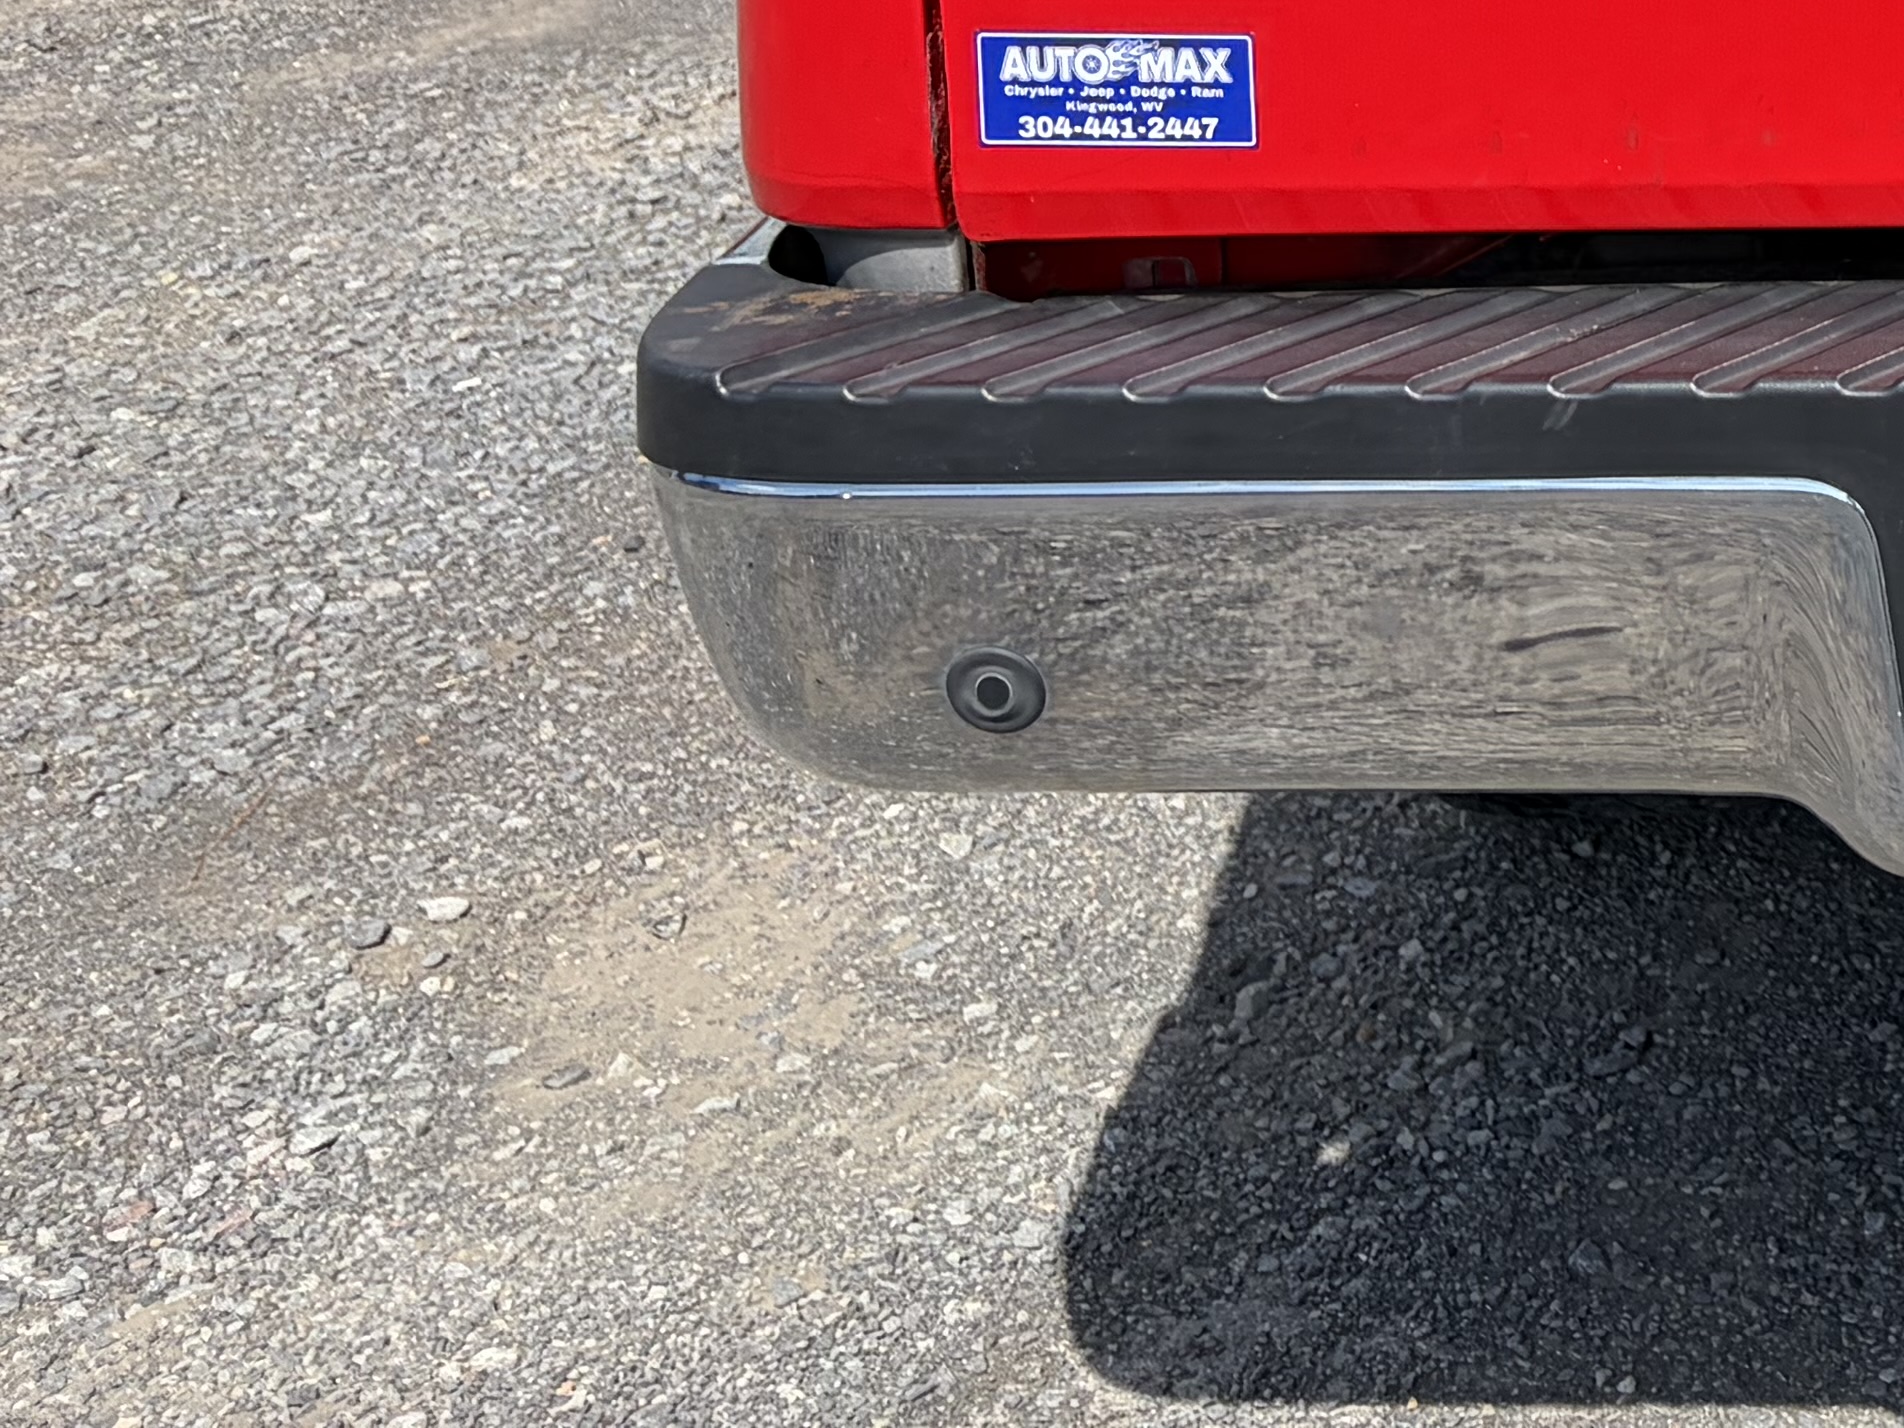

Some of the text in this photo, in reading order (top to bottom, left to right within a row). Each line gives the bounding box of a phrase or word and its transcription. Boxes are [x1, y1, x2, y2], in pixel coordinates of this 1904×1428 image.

[1000, 45, 1234, 84] AUTO MAX
[1004, 84, 1224, 100] Chrysler Jeep Dodge Ram
[1141, 101, 1164, 112] WV
[1018, 115, 1219, 139] 304-441-2447
